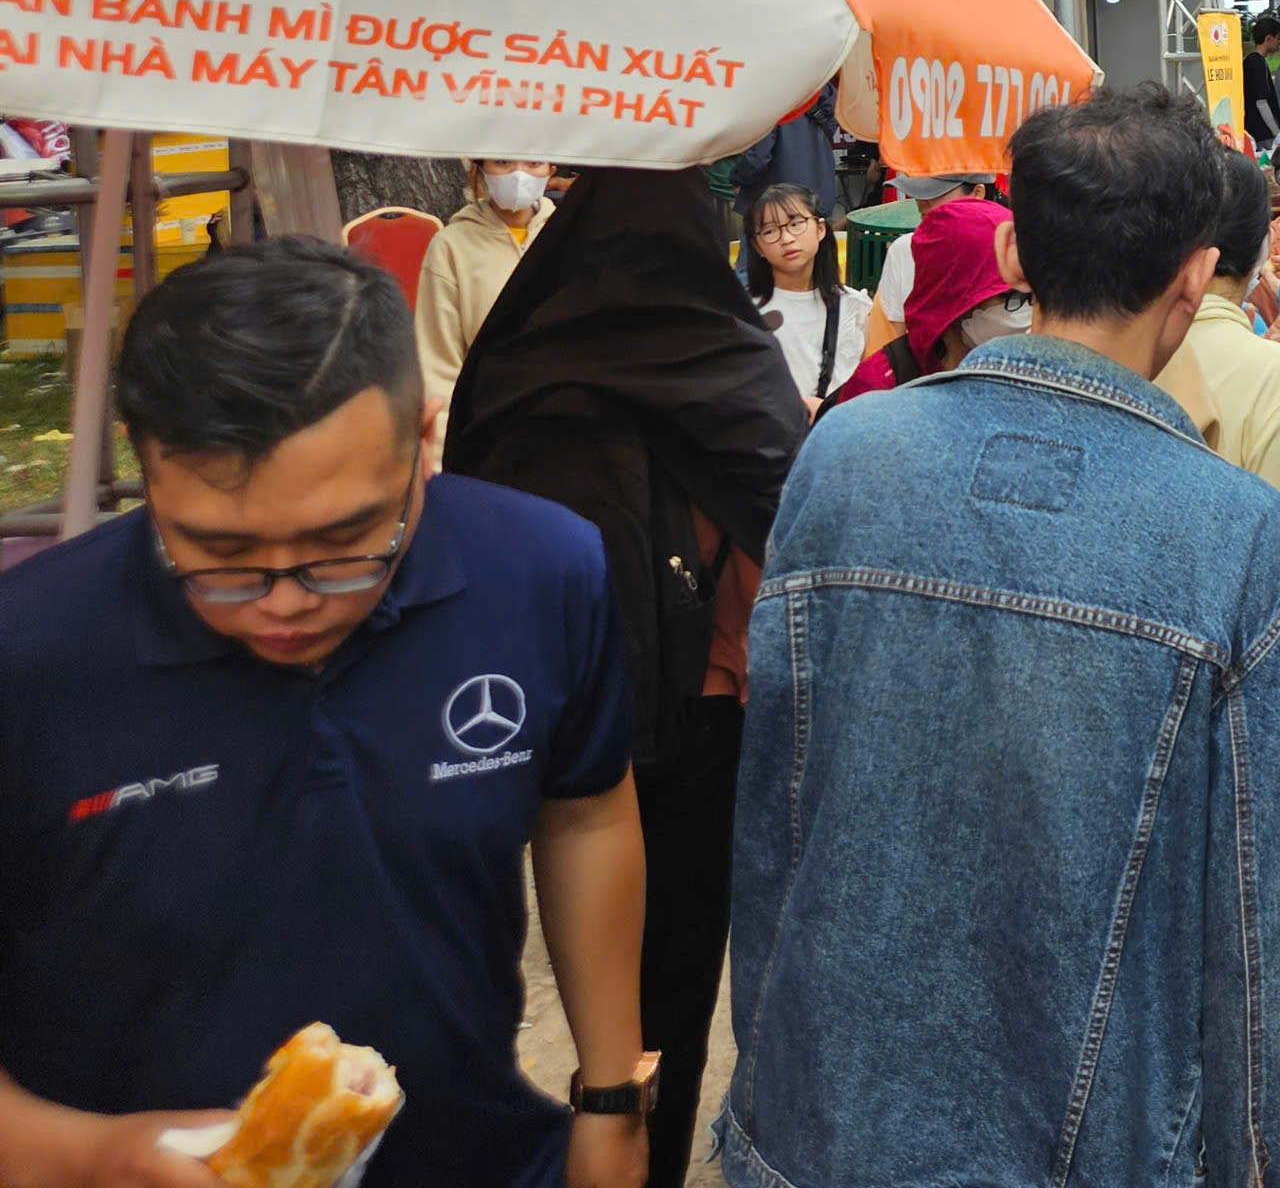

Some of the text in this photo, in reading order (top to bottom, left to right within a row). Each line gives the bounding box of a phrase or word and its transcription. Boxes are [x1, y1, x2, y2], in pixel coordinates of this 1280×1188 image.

[58, 35, 175, 81] NHÀ
[190, 46, 320, 91] MÁY
[327, 58, 430, 101] TÂN
[580, 87, 705, 129] PHÁT
[267, 1, 333, 43] MÌ
[345, 13, 491, 62] ĐƯỢC
[504, 29, 609, 72] SẢN
[621, 47, 746, 91] XUẤT
[889, 56, 966, 141] 0902
[977, 64, 1024, 138] 777
[110, 763, 220, 811] AMG
[433, 750, 533, 779] Mercedes-Benz
